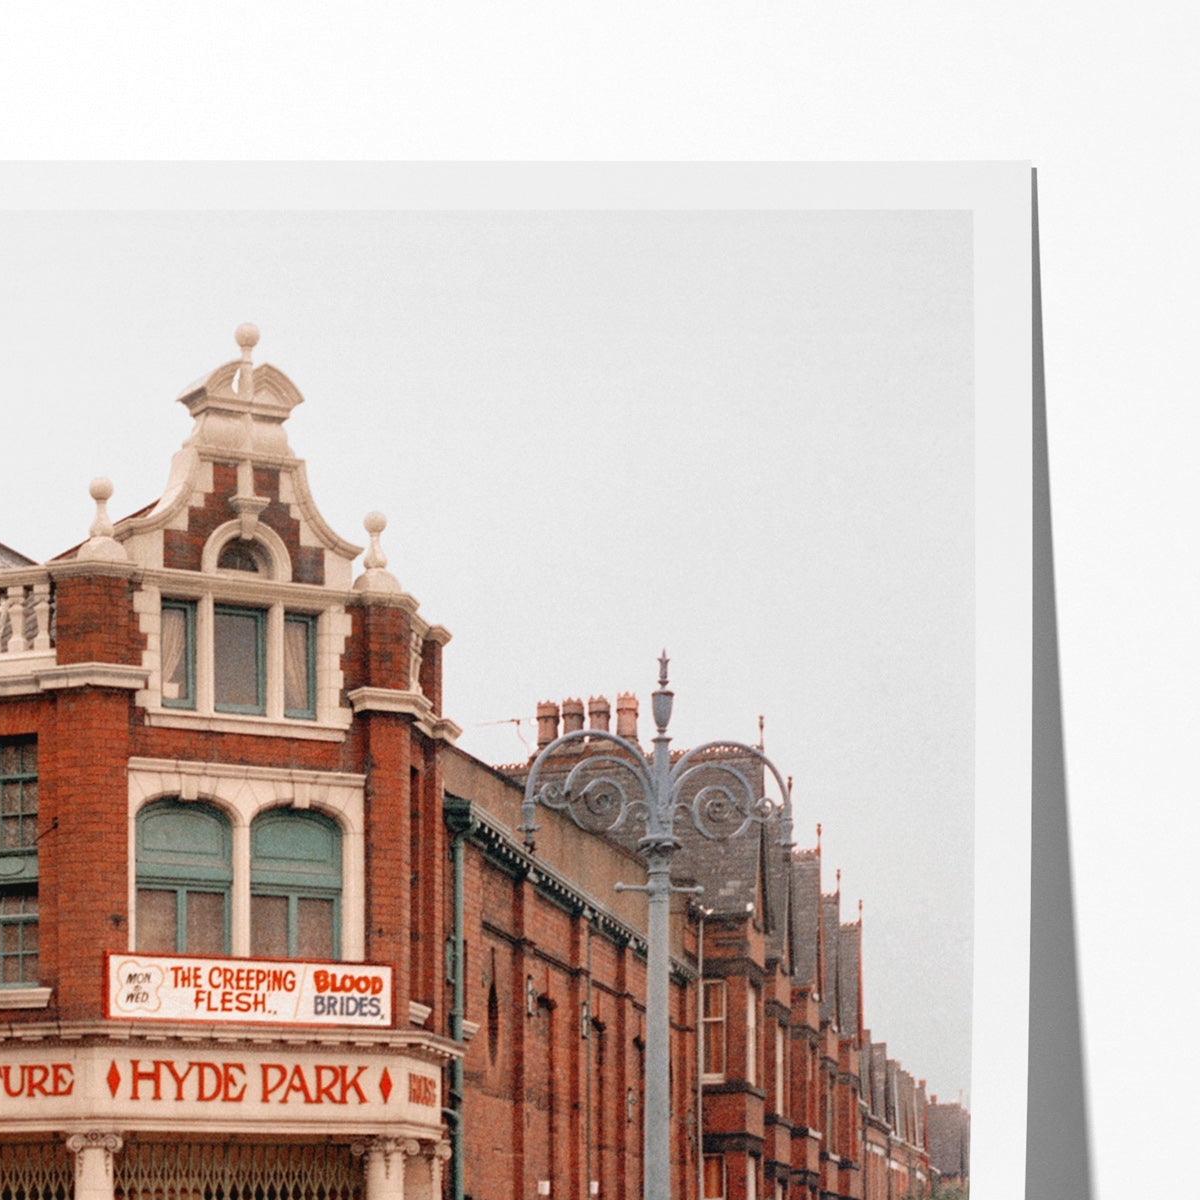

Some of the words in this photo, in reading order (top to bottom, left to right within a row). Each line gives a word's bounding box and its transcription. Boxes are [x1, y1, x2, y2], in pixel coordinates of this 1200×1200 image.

[170, 966, 201, 989] THE
[313, 970, 384, 995] BLOOD
[130, 1059, 248, 1101] HYDE
[260, 1063, 368, 1104] PARK
